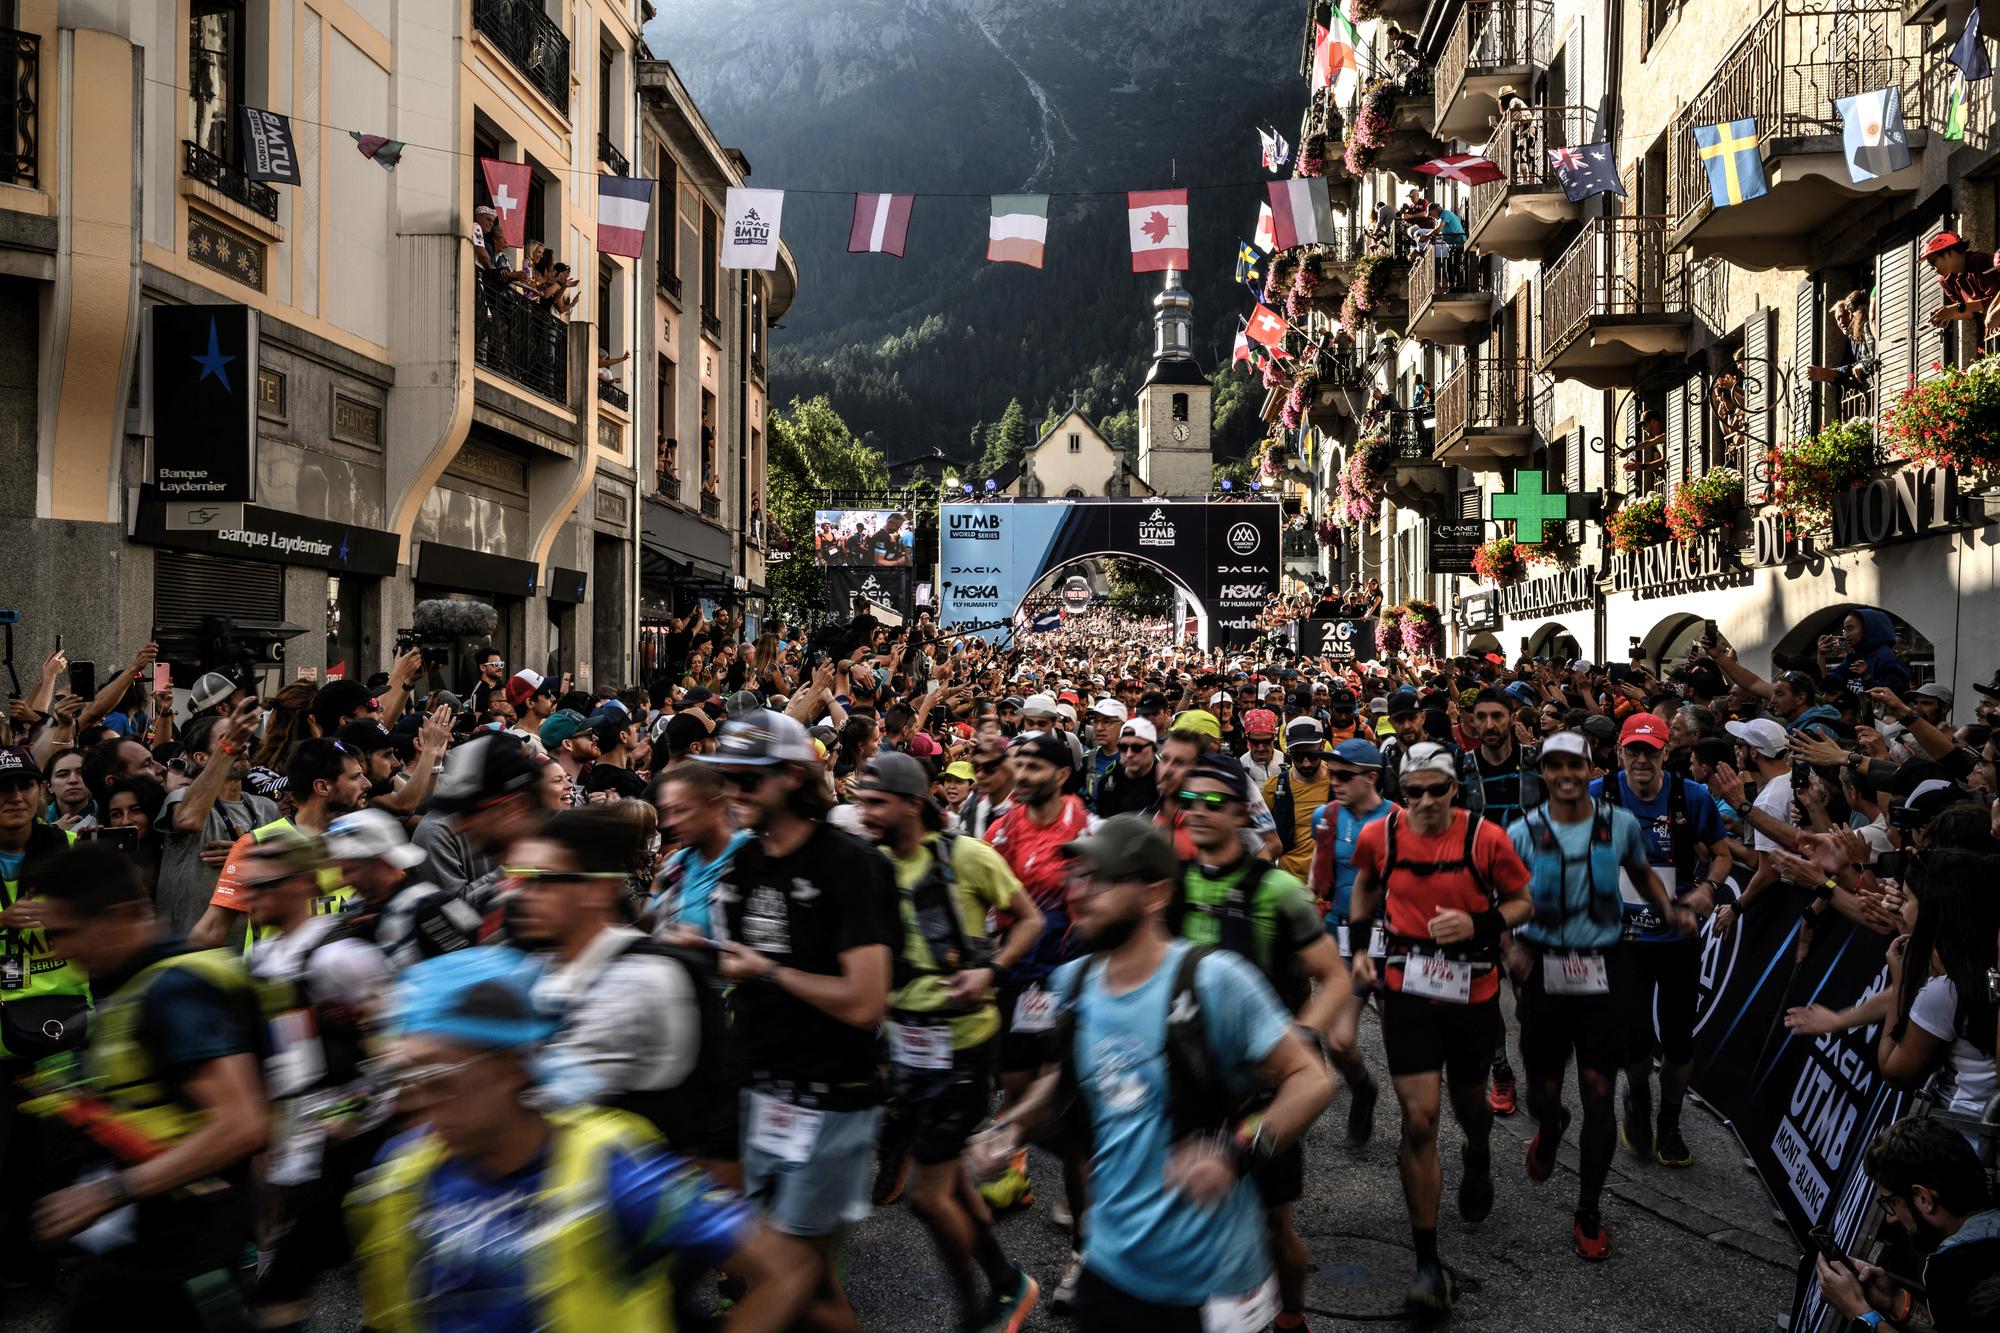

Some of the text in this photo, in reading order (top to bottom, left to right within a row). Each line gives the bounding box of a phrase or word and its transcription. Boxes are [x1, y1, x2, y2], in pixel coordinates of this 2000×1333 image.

[336, 404, 374, 436] CHANGE
[160, 468, 208, 480] Banque
[160, 481, 227, 494] Laydernier
[950, 514, 1000, 529] UTMB
[1139, 527, 1175, 538] UTMB
[218, 530, 332, 555] Banque Laydernier
[1610, 530, 1721, 593] PHARMACIE
[1752, 515, 1787, 567] DU
[951, 566, 1002, 574] DACIA
[1217, 565, 1270, 573] DACIA
[953, 585, 999, 599] HOKA
[1218, 615, 1259, 630] waho
[1321, 622, 1351, 641] 20
[1321, 641, 1352, 652] ANS
[30, 959, 65, 973] SERIES
[1790, 1055, 1858, 1171] UTMB
